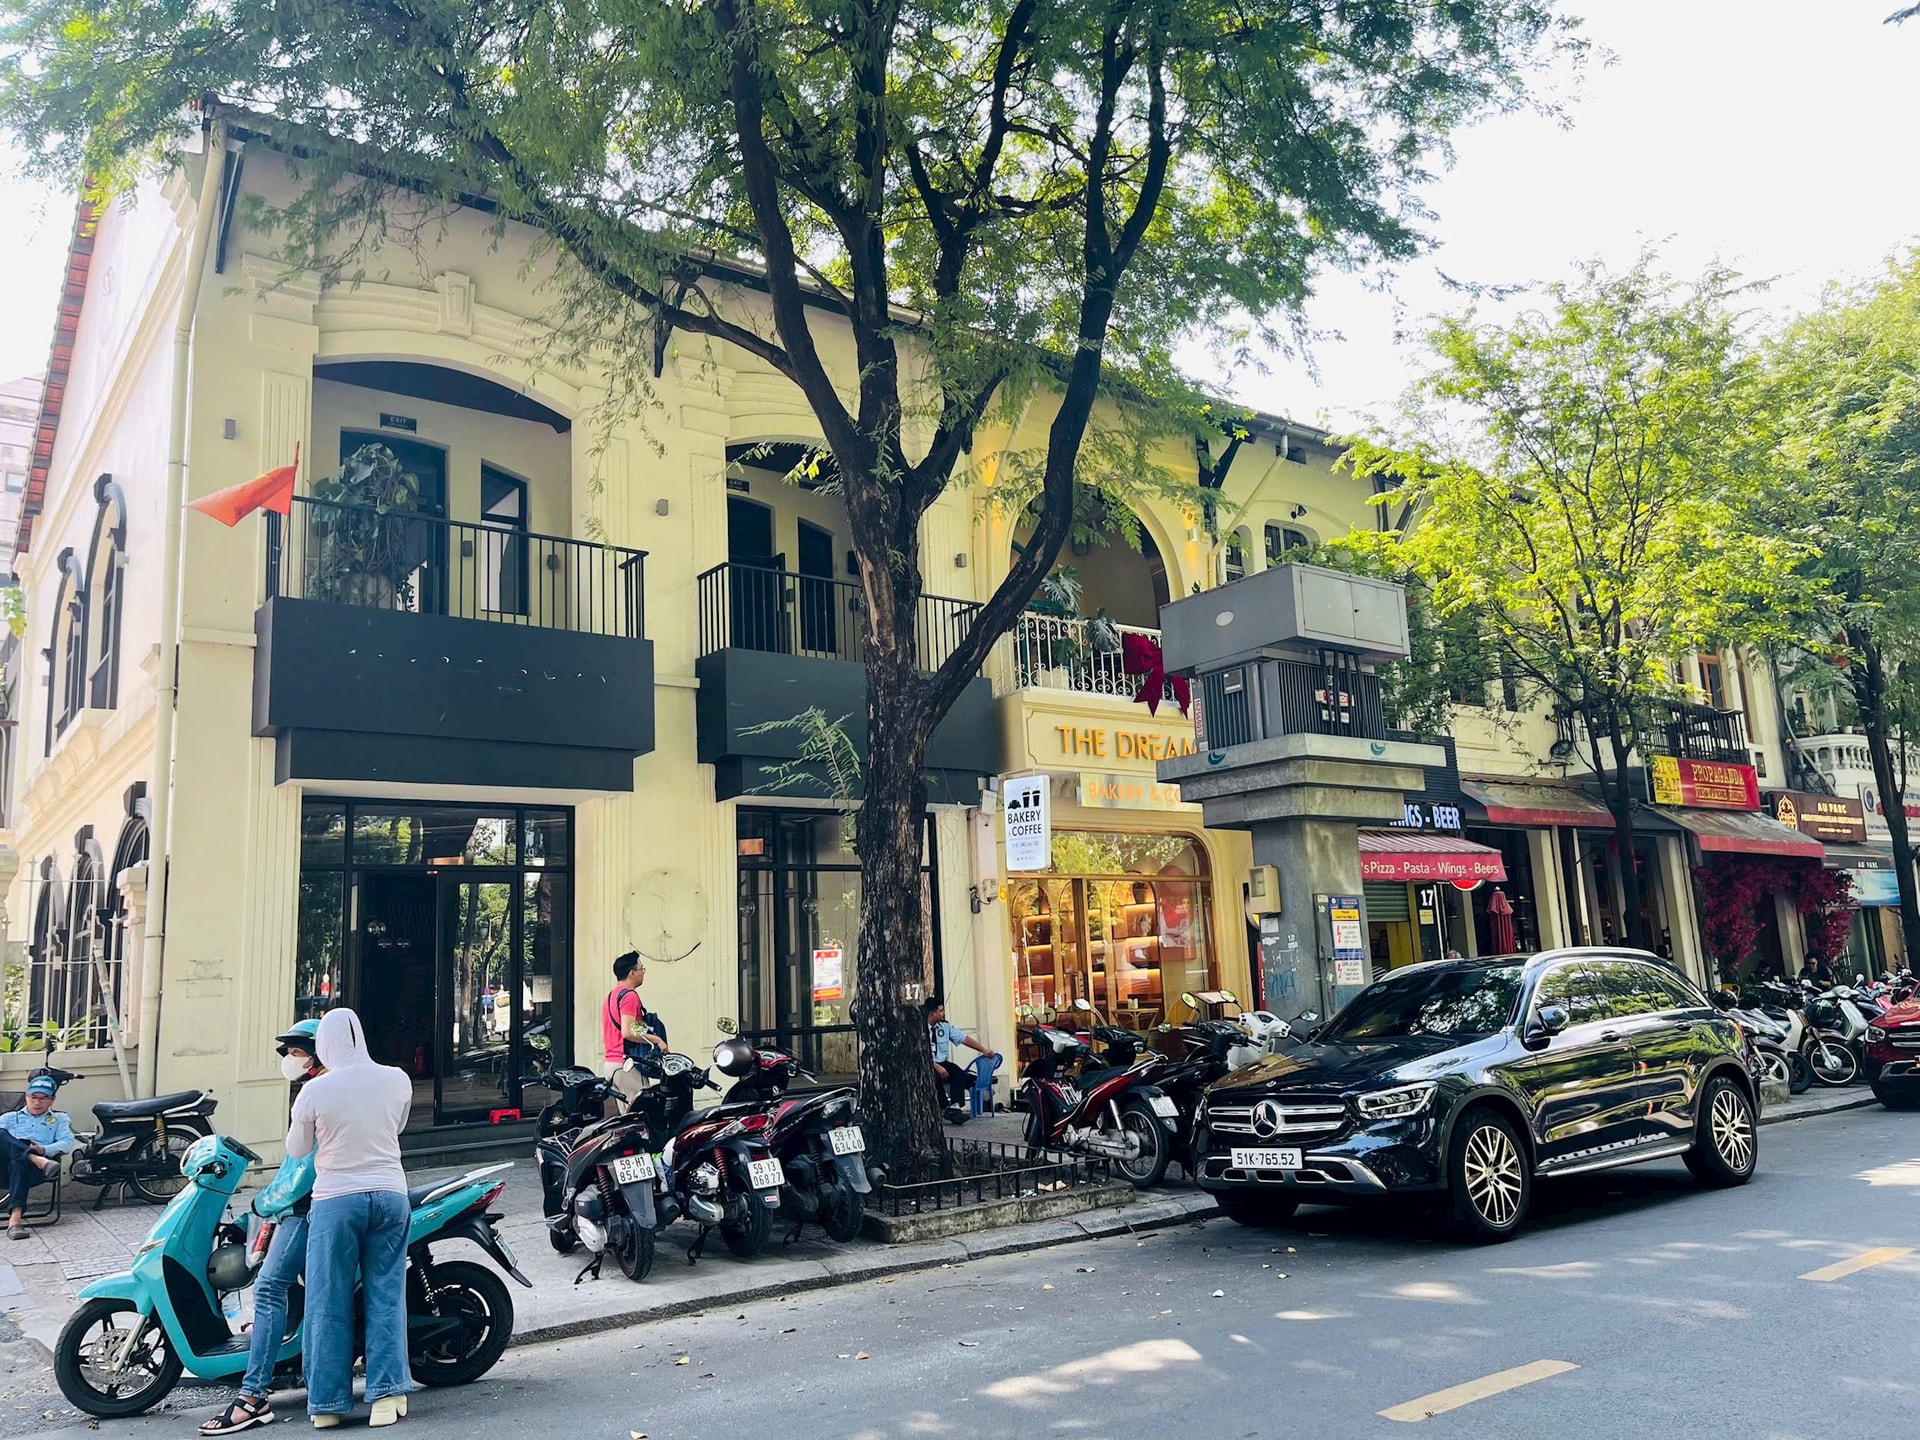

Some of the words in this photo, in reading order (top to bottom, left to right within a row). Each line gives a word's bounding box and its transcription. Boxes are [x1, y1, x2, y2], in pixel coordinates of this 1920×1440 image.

[1056, 725, 1107, 757] THE
[1691, 764, 1745, 785] PROPAGANDA
[1088, 782, 1143, 801] BAKERY
[1151, 788, 1160, 802] &
[1817, 802, 1828, 812] AU
[1829, 803, 1847, 814] PARC
[1008, 810, 1041, 825] BAKERY
[1432, 806, 1461, 829] BEER
[1012, 824, 1042, 837] COFFEE
[1370, 861, 1395, 874] Pizza
[1403, 862, 1430, 874] Pasta
[1437, 861, 1466, 877] Wings
[1474, 862, 1499, 874] Beers
[1420, 889, 1434, 906] 17
[905, 983, 920, 1000] 17
[834, 1129, 856, 1141] 59-F1
[619, 1156, 646, 1170] 59-H1
[1236, 1153, 1295, 1165] 51K-765.52
